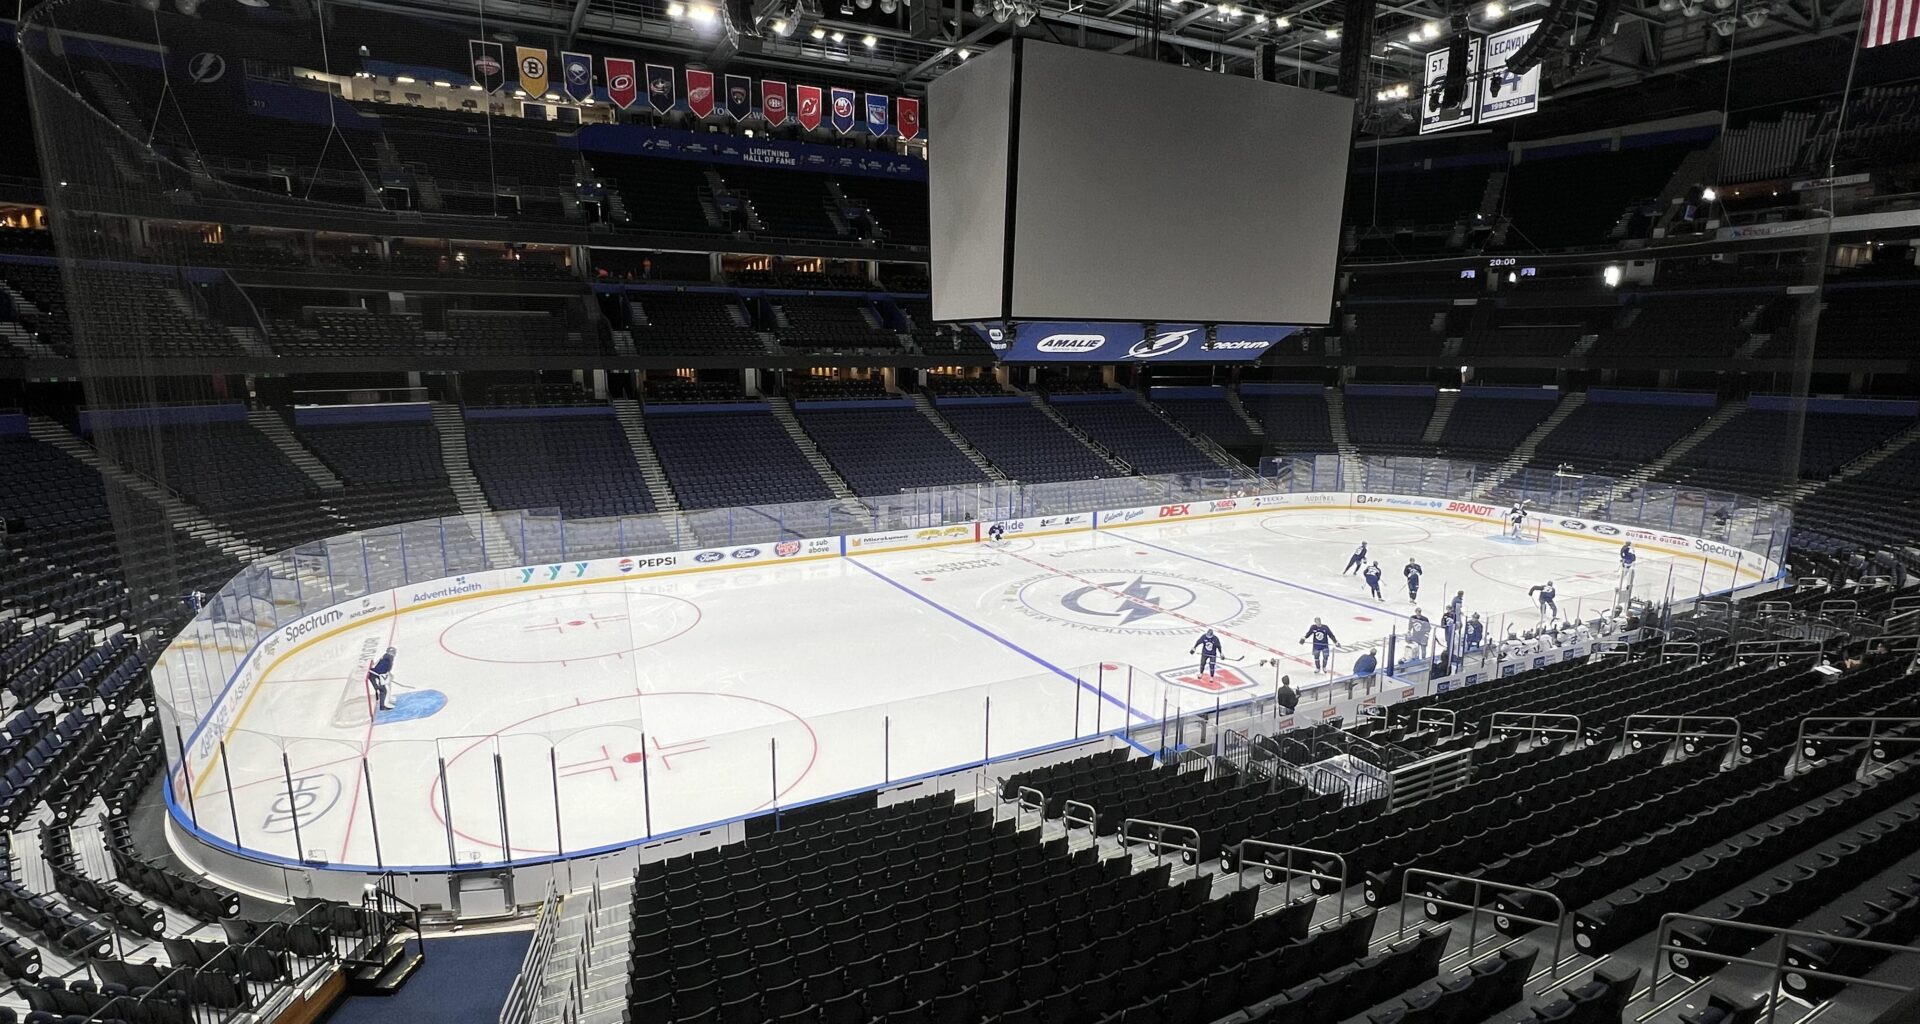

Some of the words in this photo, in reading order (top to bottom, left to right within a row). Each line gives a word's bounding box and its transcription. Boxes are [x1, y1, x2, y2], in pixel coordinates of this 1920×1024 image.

[528, 61, 539, 74] B
[1432, 58, 1445, 73] ST.
[743, 153, 763, 163] HALL
[764, 156, 774, 164] OF
[775, 157, 796, 166] FAME
[749, 148, 790, 158] LIGHTNING
[1042, 340, 1102, 348] AMALIE
[1159, 504, 1191, 518] DEX
[1446, 501, 1496, 517] BRANDT
[1626, 530, 1657, 541] OUTBACK
[1659, 537, 1690, 547] OUTBACK
[638, 557, 676, 568] PEPSI
[286, 610, 340, 642] Spectrum
